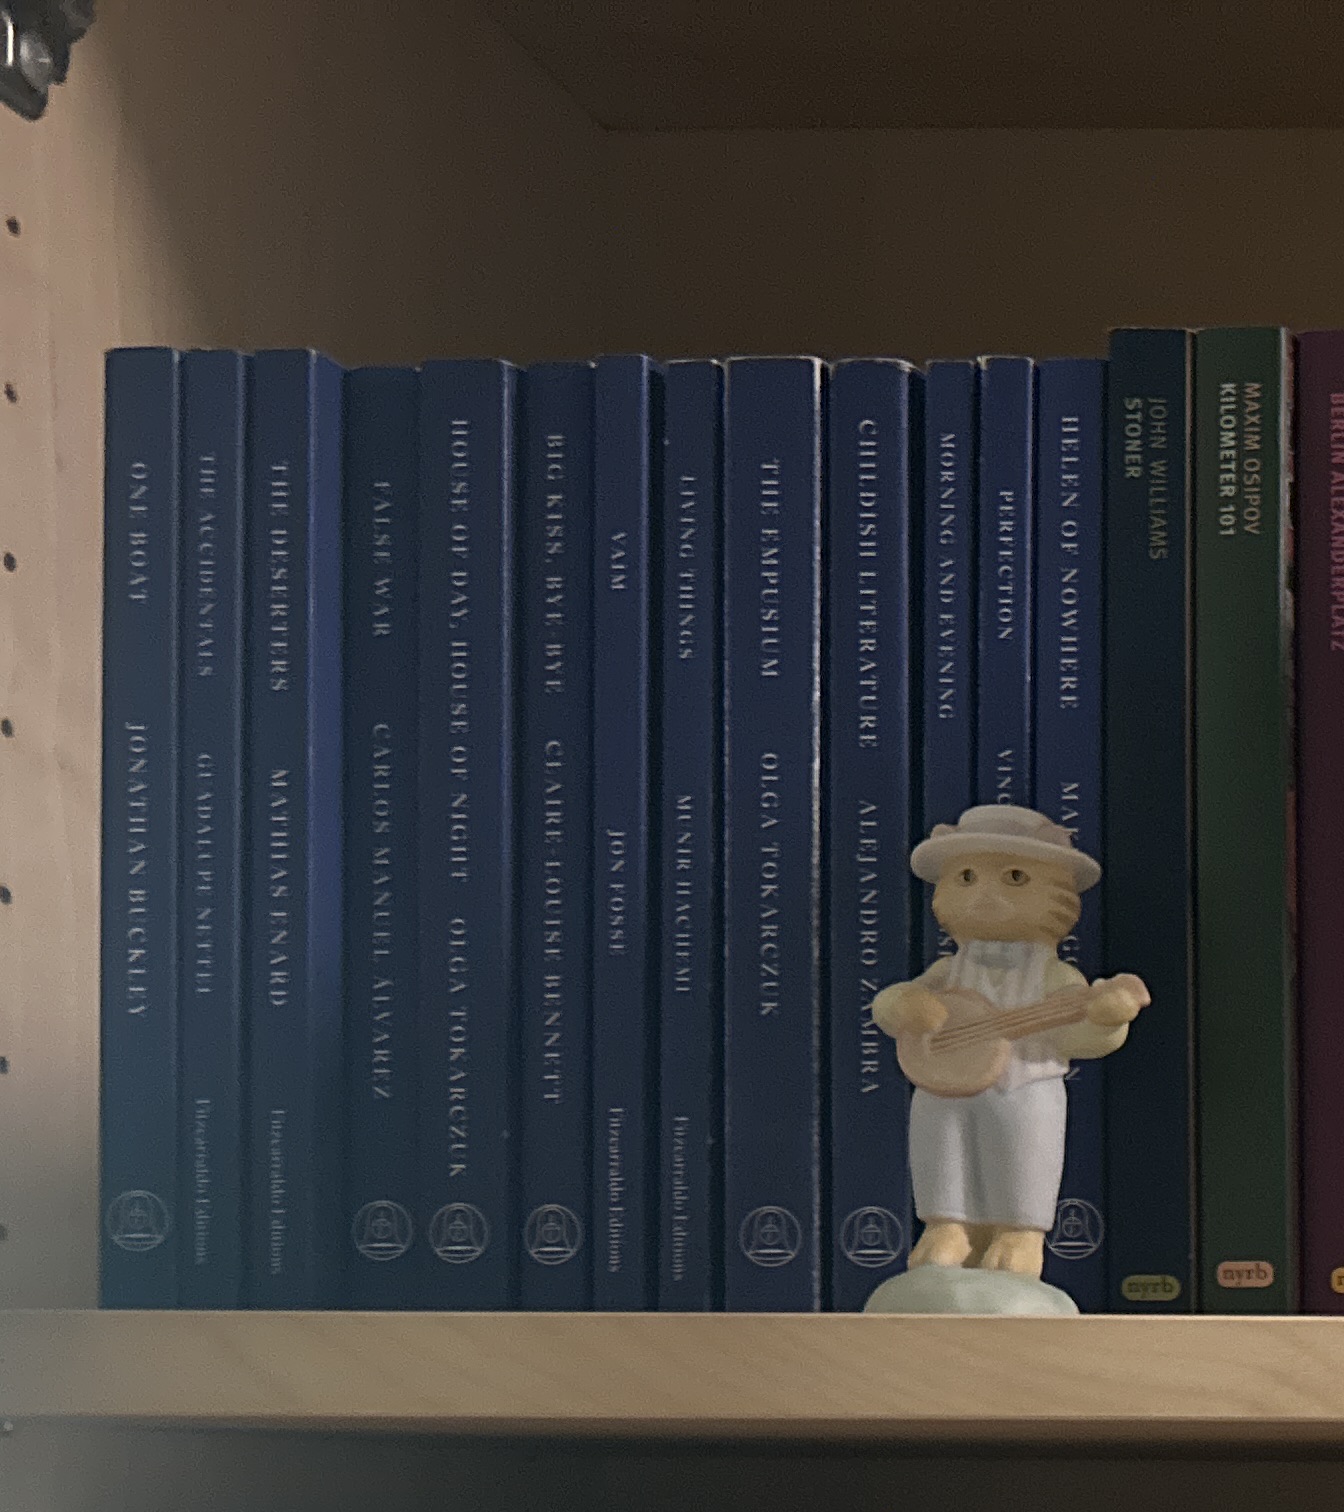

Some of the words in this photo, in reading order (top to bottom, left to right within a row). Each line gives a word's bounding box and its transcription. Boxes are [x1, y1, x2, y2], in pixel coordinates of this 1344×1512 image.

[1123, 397, 1142, 478] STONER
[1147, 396, 1167, 449] JOHN
[1217, 383, 1236, 498] KILOMETER
[1242, 383, 1261, 450] MAXIM
[126, 461, 146, 520] ONE
[759, 459, 780, 514] THE
[856, 419, 878, 561] CHILDISH
[1147, 461, 1167, 560] WILLIAMS
[1217, 504, 1236, 537] 101
[1242, 458, 1261, 534] OSIPOV
[126, 532, 146, 604] BOAT
[759, 529, 780, 677] EMPUSIUM
[856, 573, 878, 748] LITERATURE
[125, 723, 148, 878] JONATHAN
[758, 752, 780, 828] OLGA
[855, 800, 880, 966] ALEJANDRO
[125, 888, 148, 1017] BUCKLEY
[758, 843, 780, 1017] TOKARCZUK
